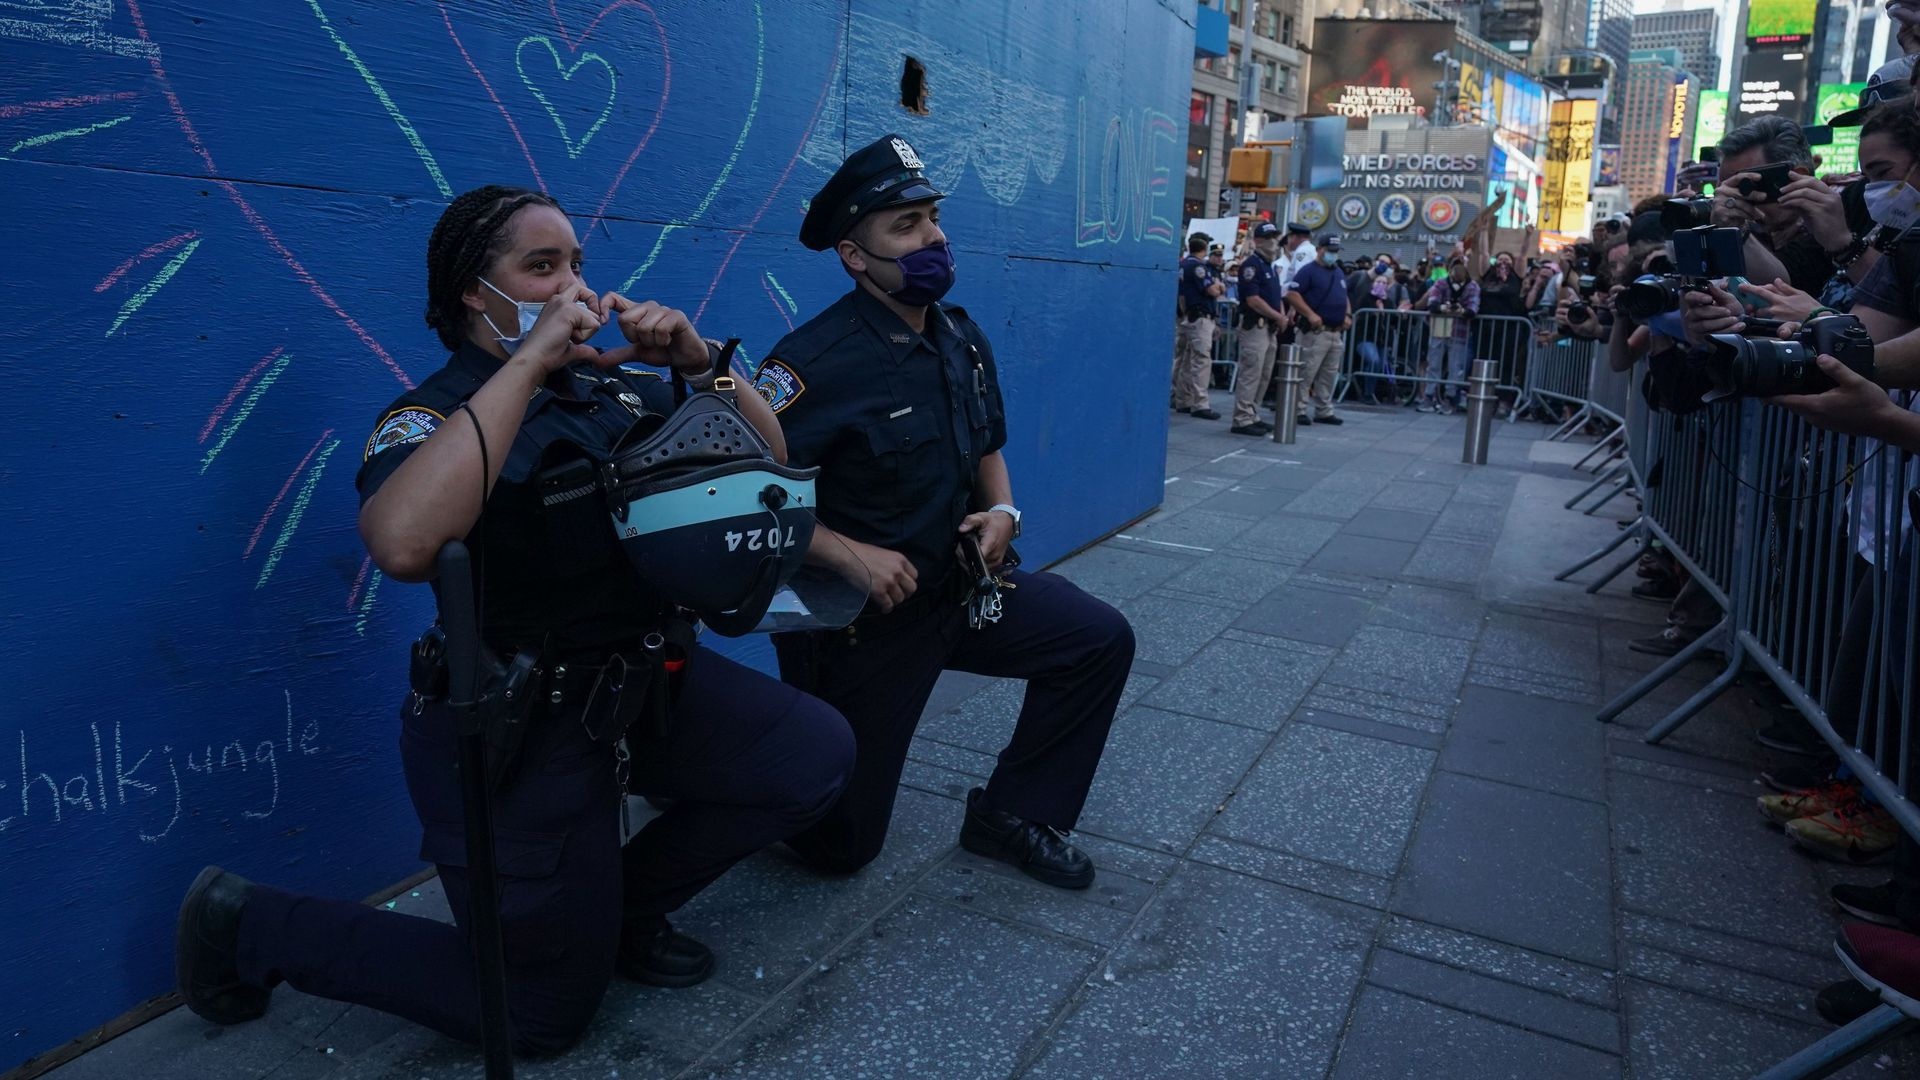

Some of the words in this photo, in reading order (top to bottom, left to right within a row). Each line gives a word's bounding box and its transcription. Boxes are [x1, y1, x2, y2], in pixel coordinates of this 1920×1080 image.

[1344, 85, 1366, 96] THE
[1340, 94, 1368, 105] MOST
[1370, 96, 1416, 106] TRUSTED
[1669, 79, 1689, 139] NOVOTEL
[1342, 153, 1393, 171] RMED
[1395, 153, 1477, 171] FORCES
[1076, 96, 1178, 248] LOVE
[1392, 173, 1466, 188] STATION
[761, 367, 795, 397] DEPARTMENT
[772, 364, 794, 384] POLICE
[773, 398, 788, 411] ORK
[400, 410, 433, 422] POLICE
[724, 526, 796, 552] 7024
